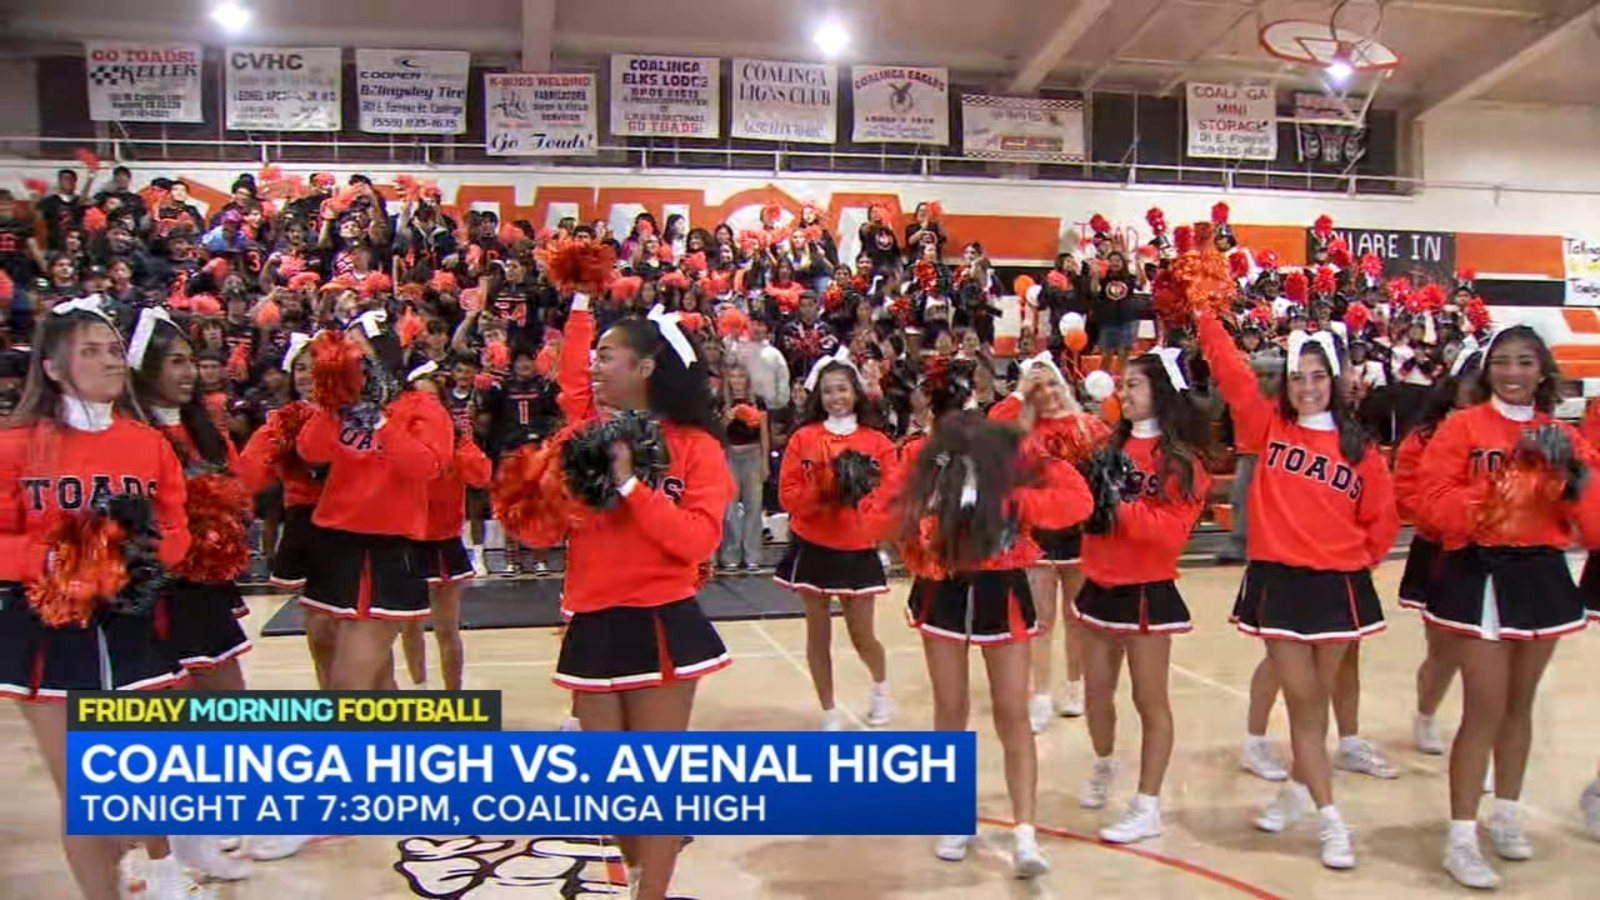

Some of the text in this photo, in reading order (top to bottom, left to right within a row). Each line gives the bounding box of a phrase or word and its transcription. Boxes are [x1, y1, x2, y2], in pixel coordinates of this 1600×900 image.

[91, 49, 120, 62] GO
[231, 52, 304, 71] CVHC
[629, 59, 702, 74] COALINGA
[743, 63, 827, 87] COALINGA
[622, 72, 658, 86] ELKS
[854, 69, 906, 90] COALINGA
[439, 86, 466, 99] Tire
[789, 86, 831, 107] CLUB
[1194, 86, 1268, 101] COALIGA
[1216, 103, 1248, 117] MINI
[492, 133, 519, 152] Go
[1357, 231, 1399, 260] ARE
[1411, 234, 1441, 262] IN
[518, 399, 529, 426] 1
[1266, 439, 1364, 501] TOADS
